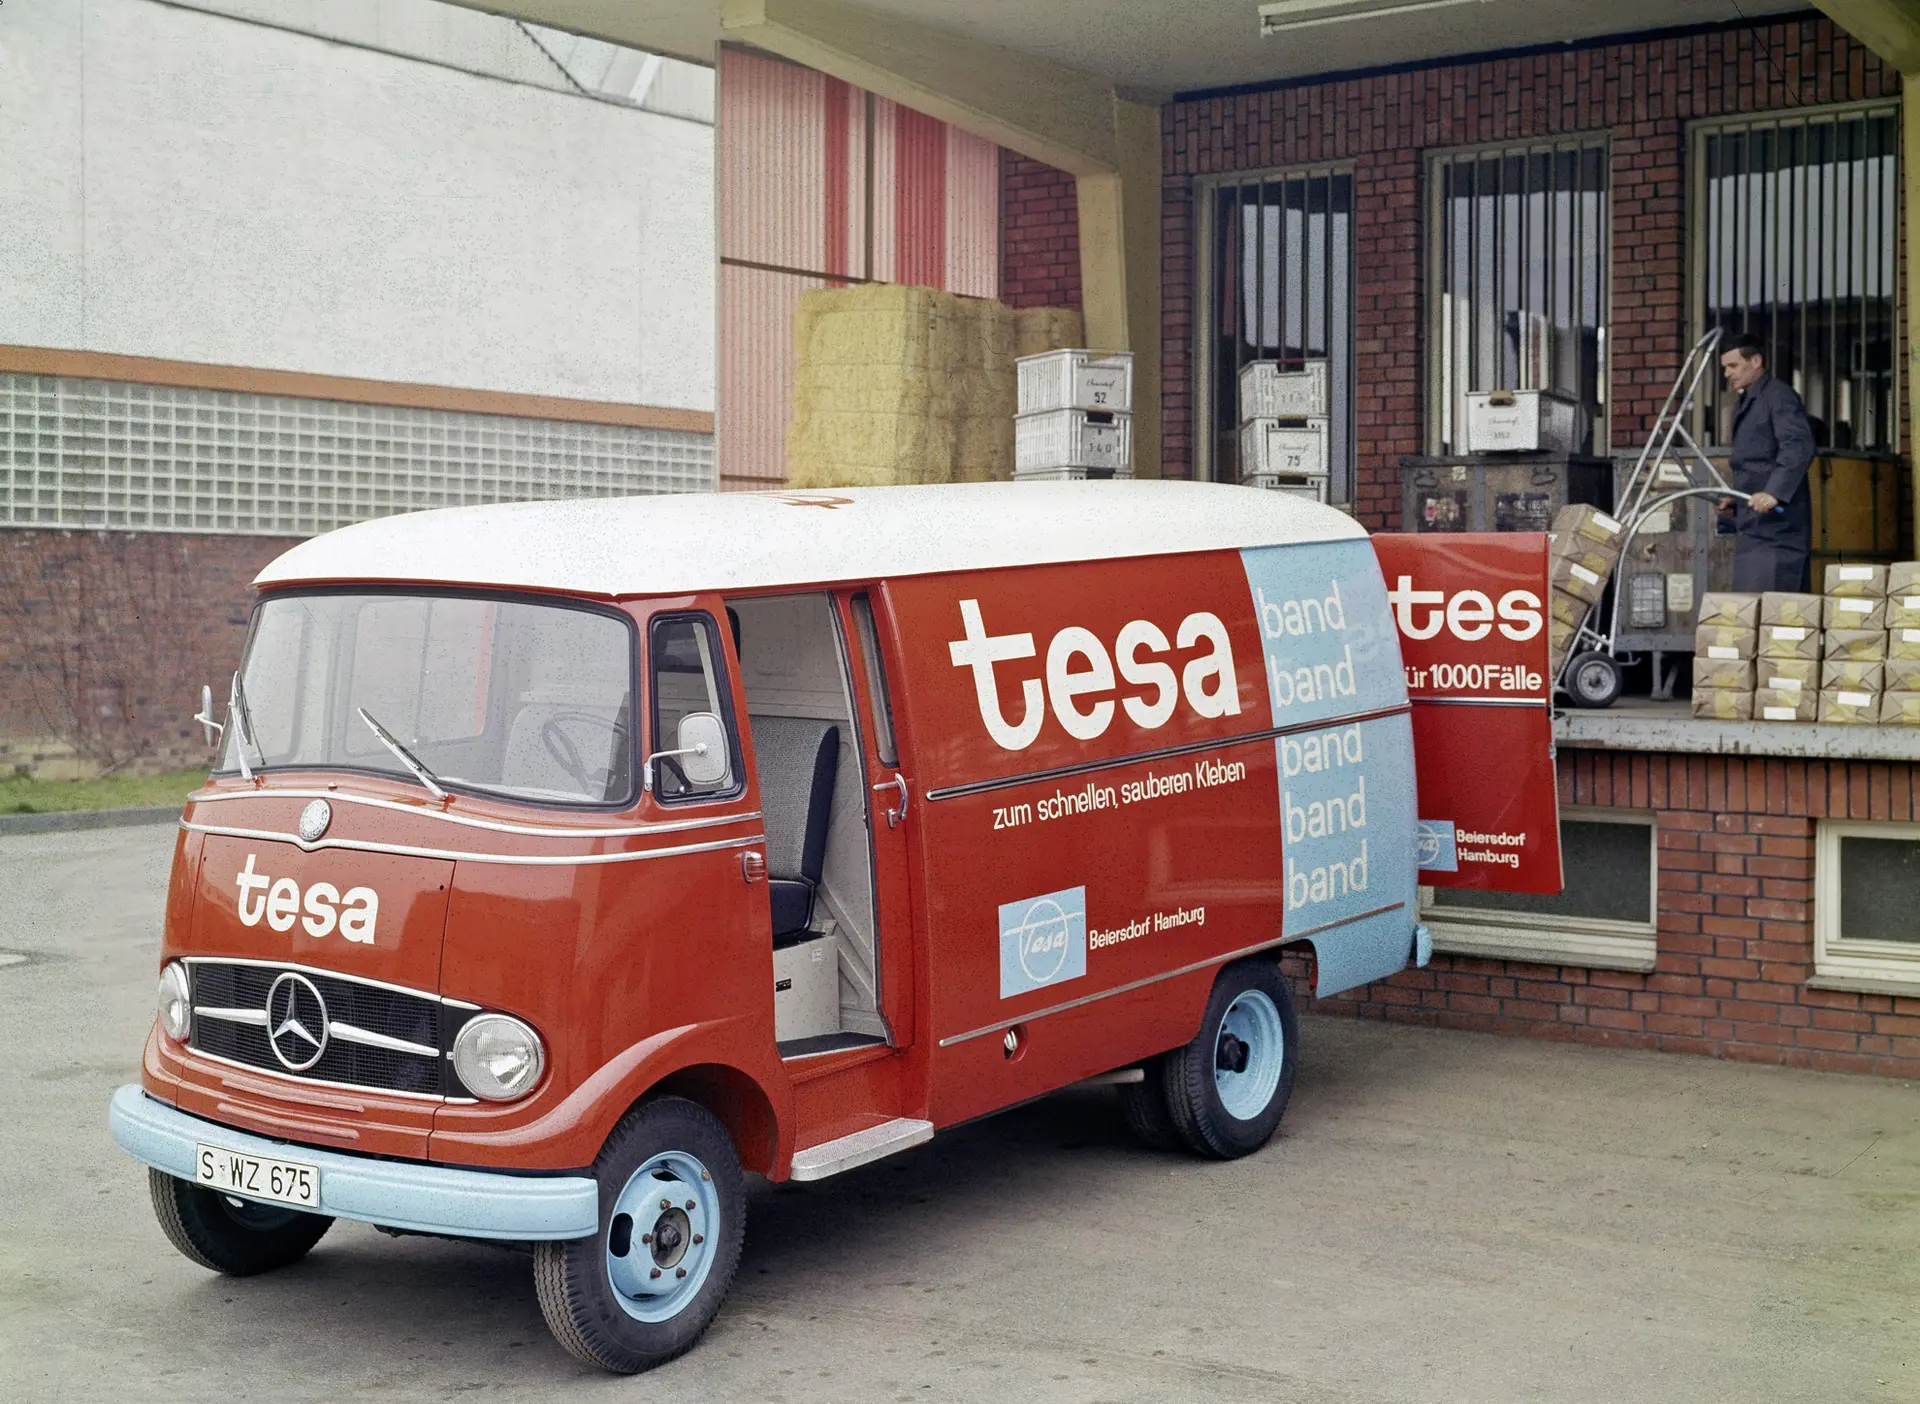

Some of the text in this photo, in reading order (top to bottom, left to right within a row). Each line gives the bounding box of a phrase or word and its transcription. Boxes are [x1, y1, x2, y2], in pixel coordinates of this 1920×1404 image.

[1093, 391, 1107, 404] 52
[1287, 455, 1301, 467] 75
[1257, 579, 1347, 640] band
[1387, 575, 1544, 641] tes
[948, 598, 1241, 751] tesa
[1270, 644, 1357, 708] band
[1405, 663, 1543, 690] ür 1000 Fälle
[1280, 722, 1363, 778] band
[993, 758, 1246, 830] zum schnellen, sauberen Kleben
[1284, 775, 1367, 844] band
[1456, 829, 1526, 846] Beiersdorf
[1457, 847, 1519, 868] Hamburg
[236, 853, 378, 944] tesa
[1288, 839, 1368, 911] band
[1089, 906, 1205, 950] Beiersdorf Hamburg
[202, 1151, 311, 1200] S WZ 675
